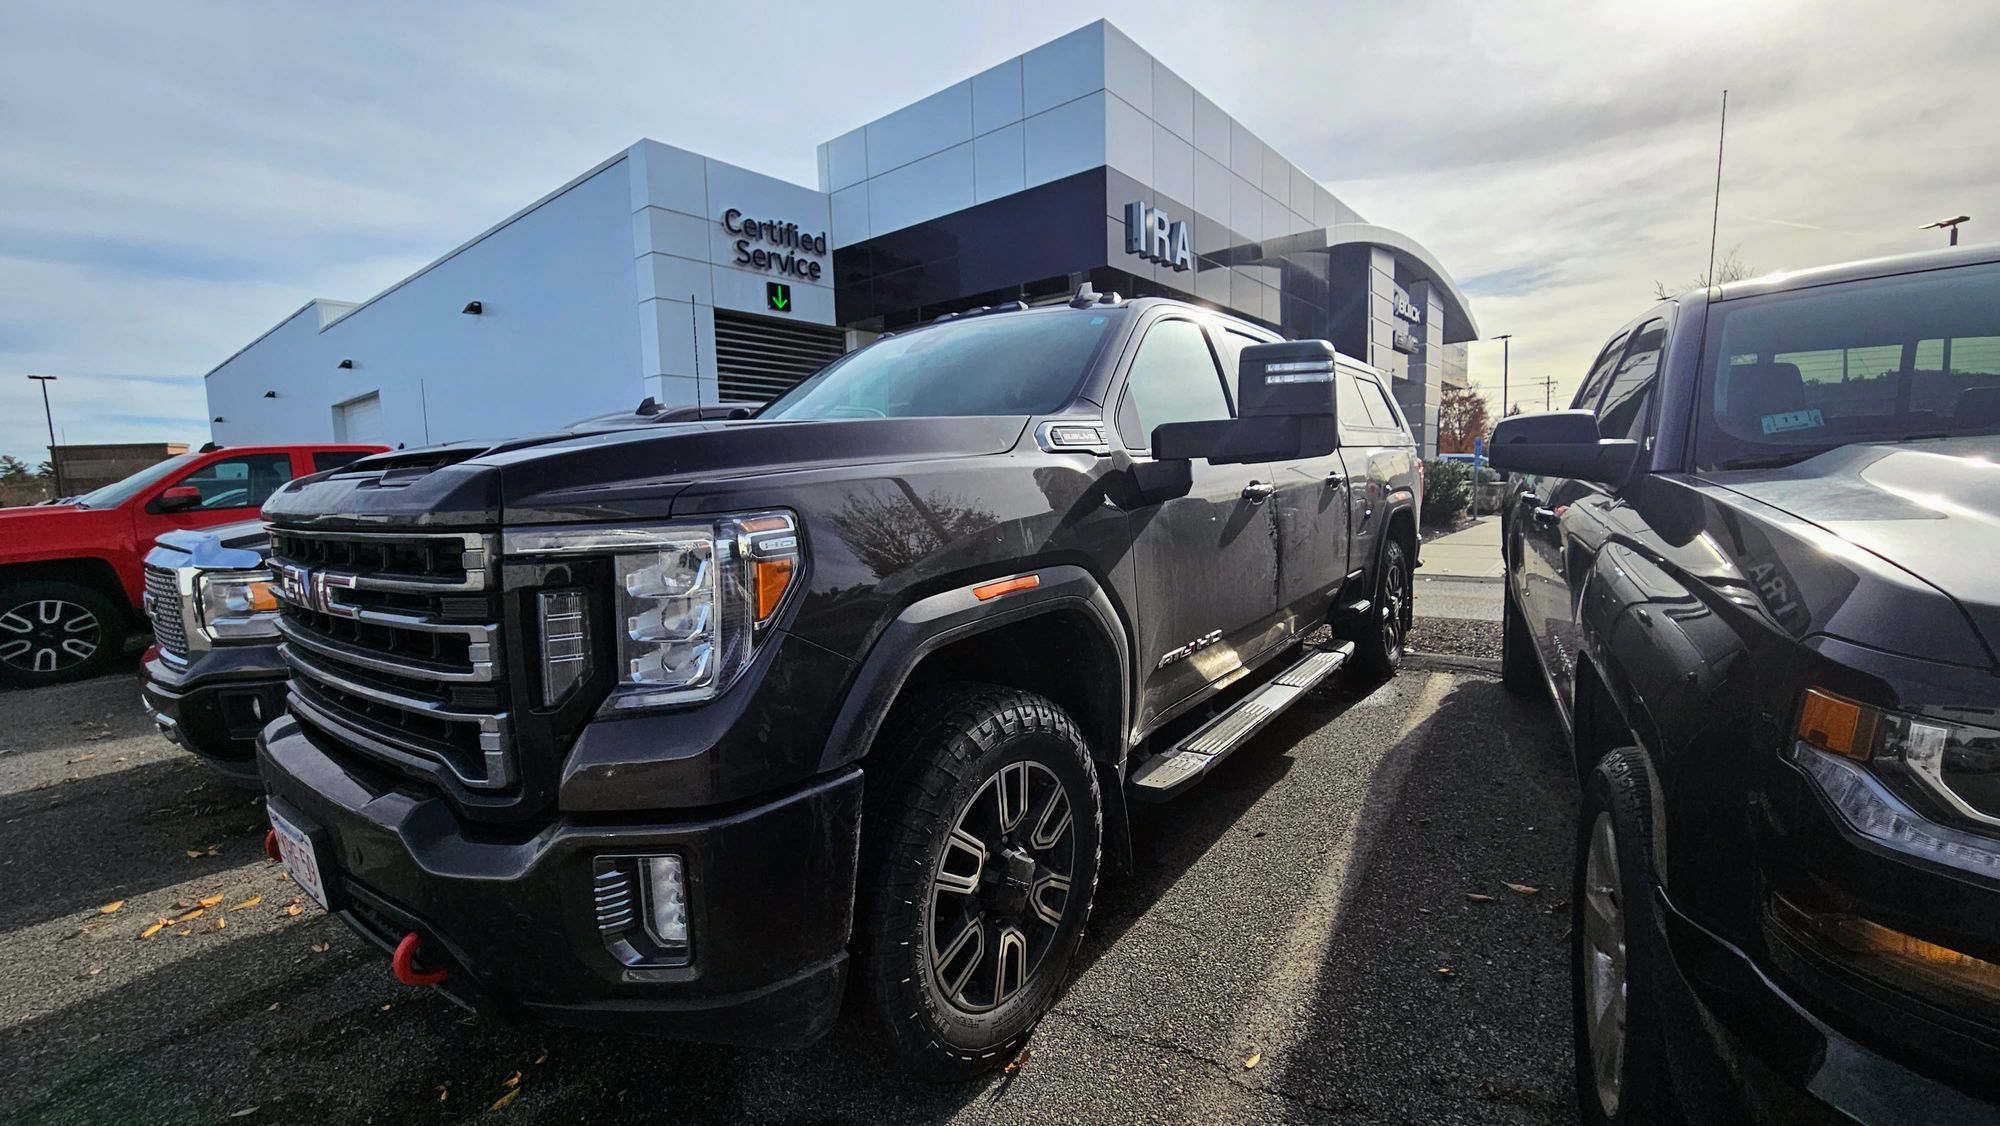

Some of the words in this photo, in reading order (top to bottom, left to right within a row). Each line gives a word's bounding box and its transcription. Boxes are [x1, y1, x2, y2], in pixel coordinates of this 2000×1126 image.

[724, 208, 826, 257] Certified
[1131, 201, 1191, 271] IRA
[735, 240, 821, 279] Service
[1399, 300, 1421, 323] BUICK
[283, 564, 359, 619] GMC
